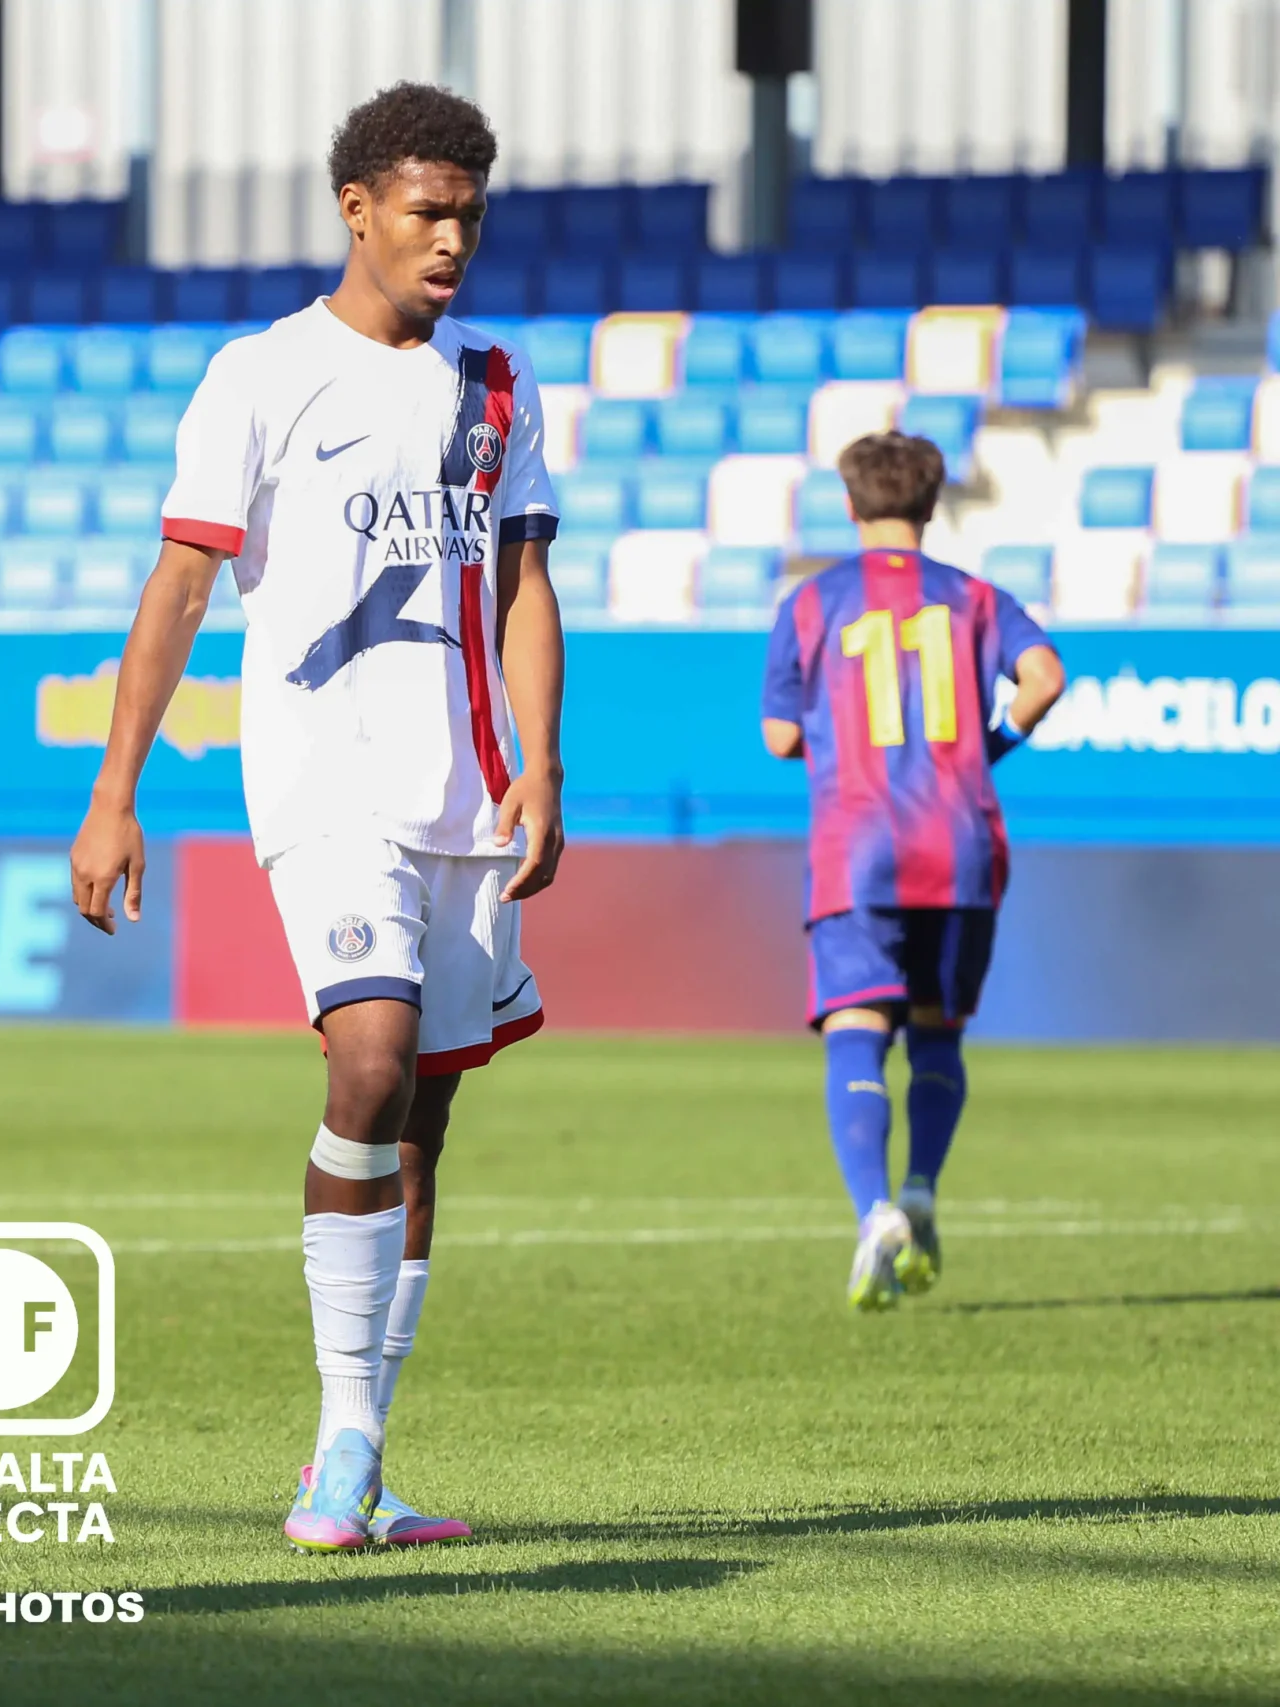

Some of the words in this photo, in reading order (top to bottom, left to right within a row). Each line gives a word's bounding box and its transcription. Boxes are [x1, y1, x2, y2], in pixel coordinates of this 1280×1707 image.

[472, 426, 498, 440] PARIS
[343, 490, 490, 541] QATAR
[384, 536, 487, 562] AIRWAYS
[840, 605, 957, 747] 11
